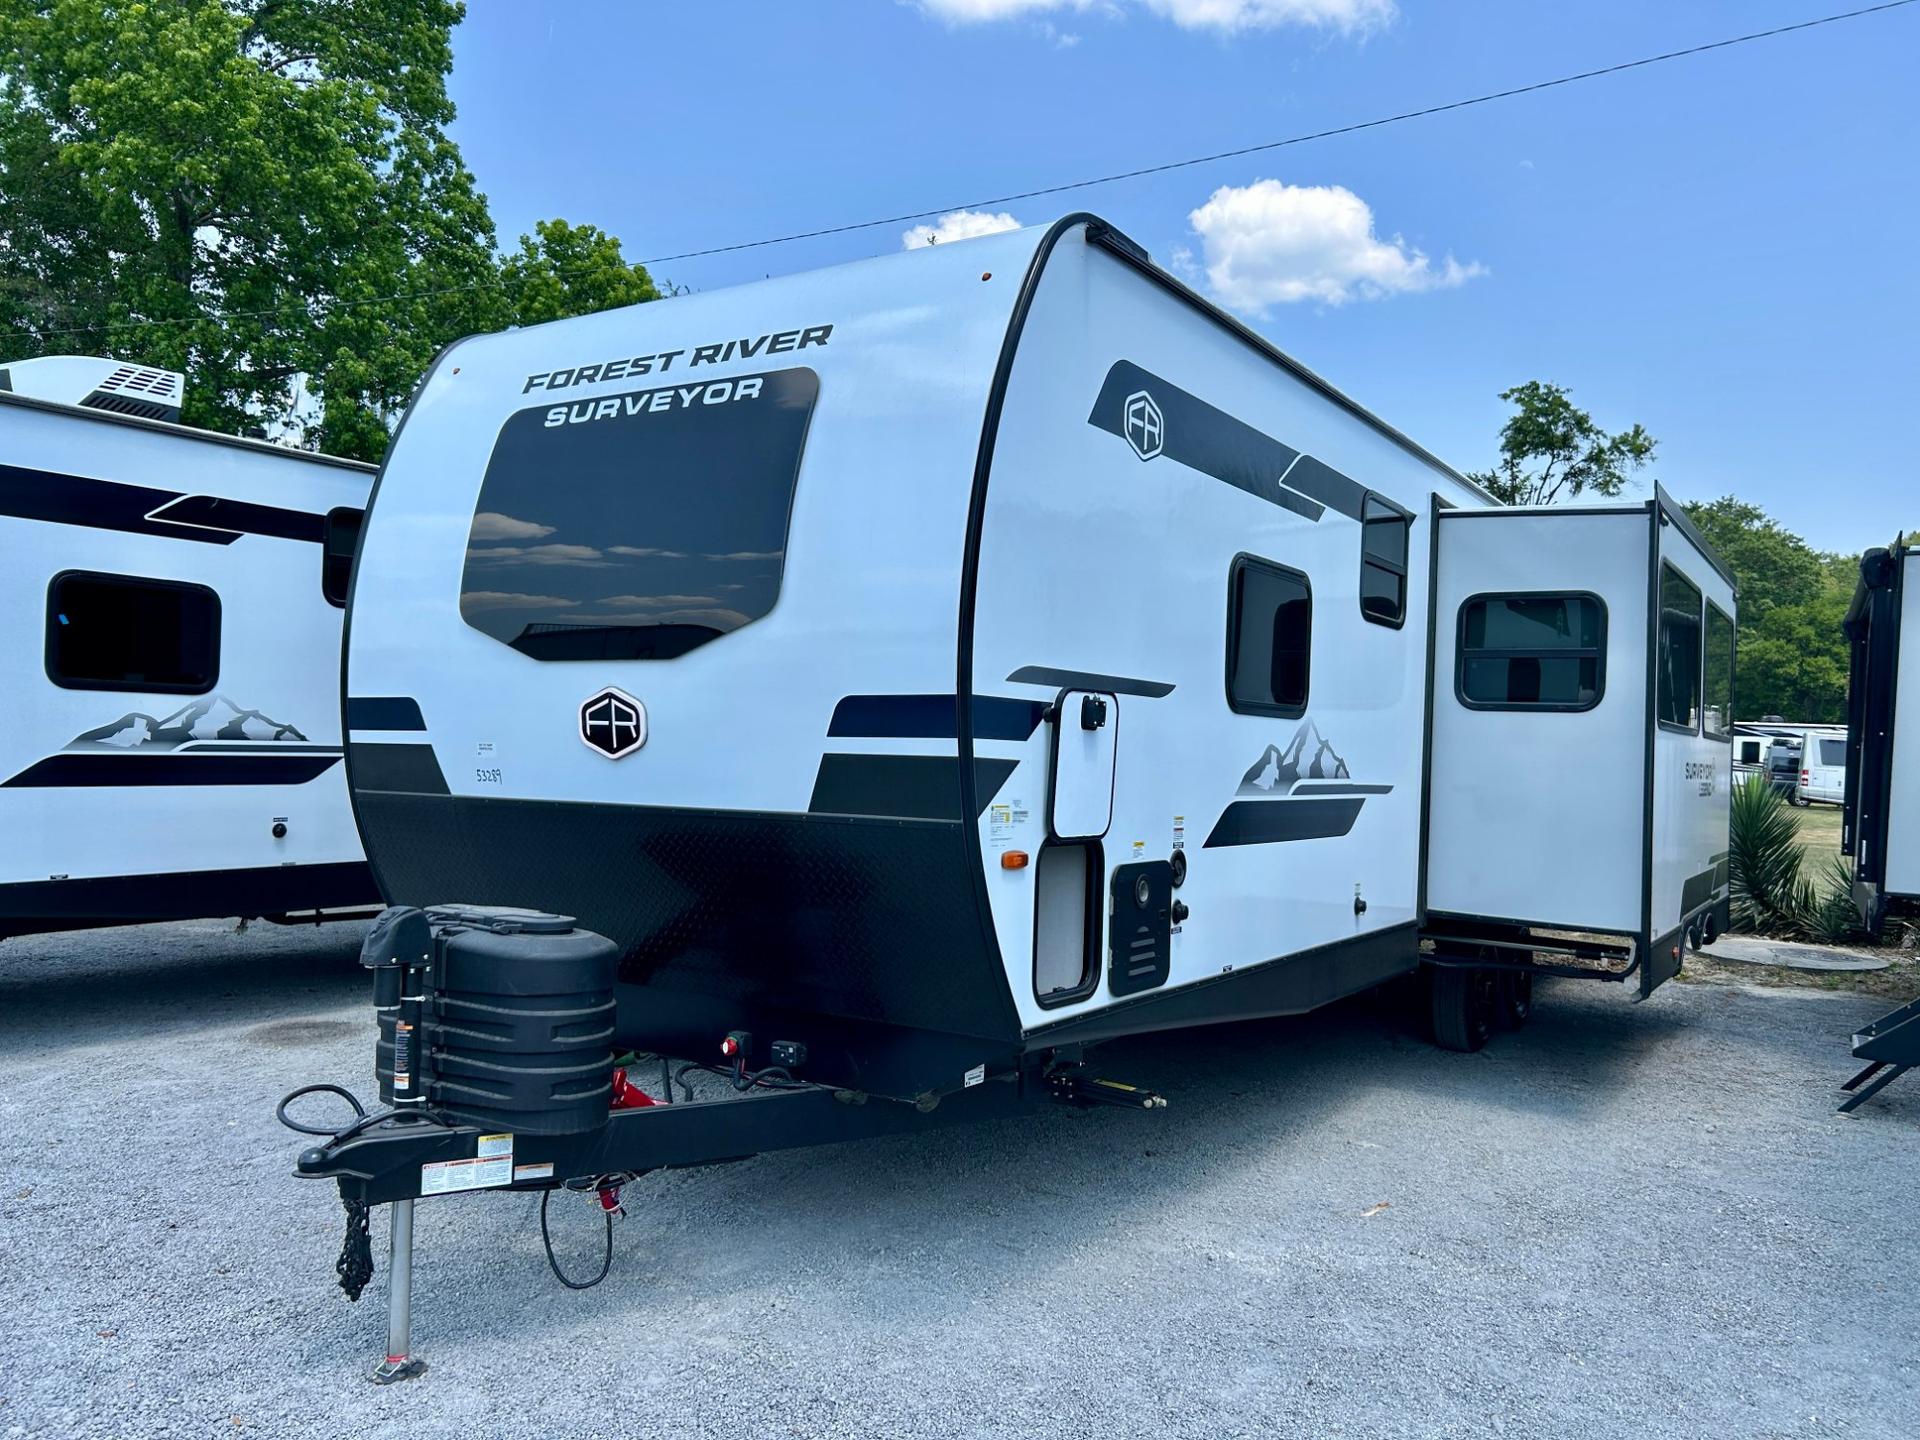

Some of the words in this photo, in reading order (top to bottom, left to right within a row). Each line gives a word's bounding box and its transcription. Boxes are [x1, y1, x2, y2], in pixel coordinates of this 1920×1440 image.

[522, 350, 685, 395] FOREST
[690, 324, 834, 367] RIVER
[544, 377, 764, 428] SURVEYOR
[476, 768, 503, 785] 53289
